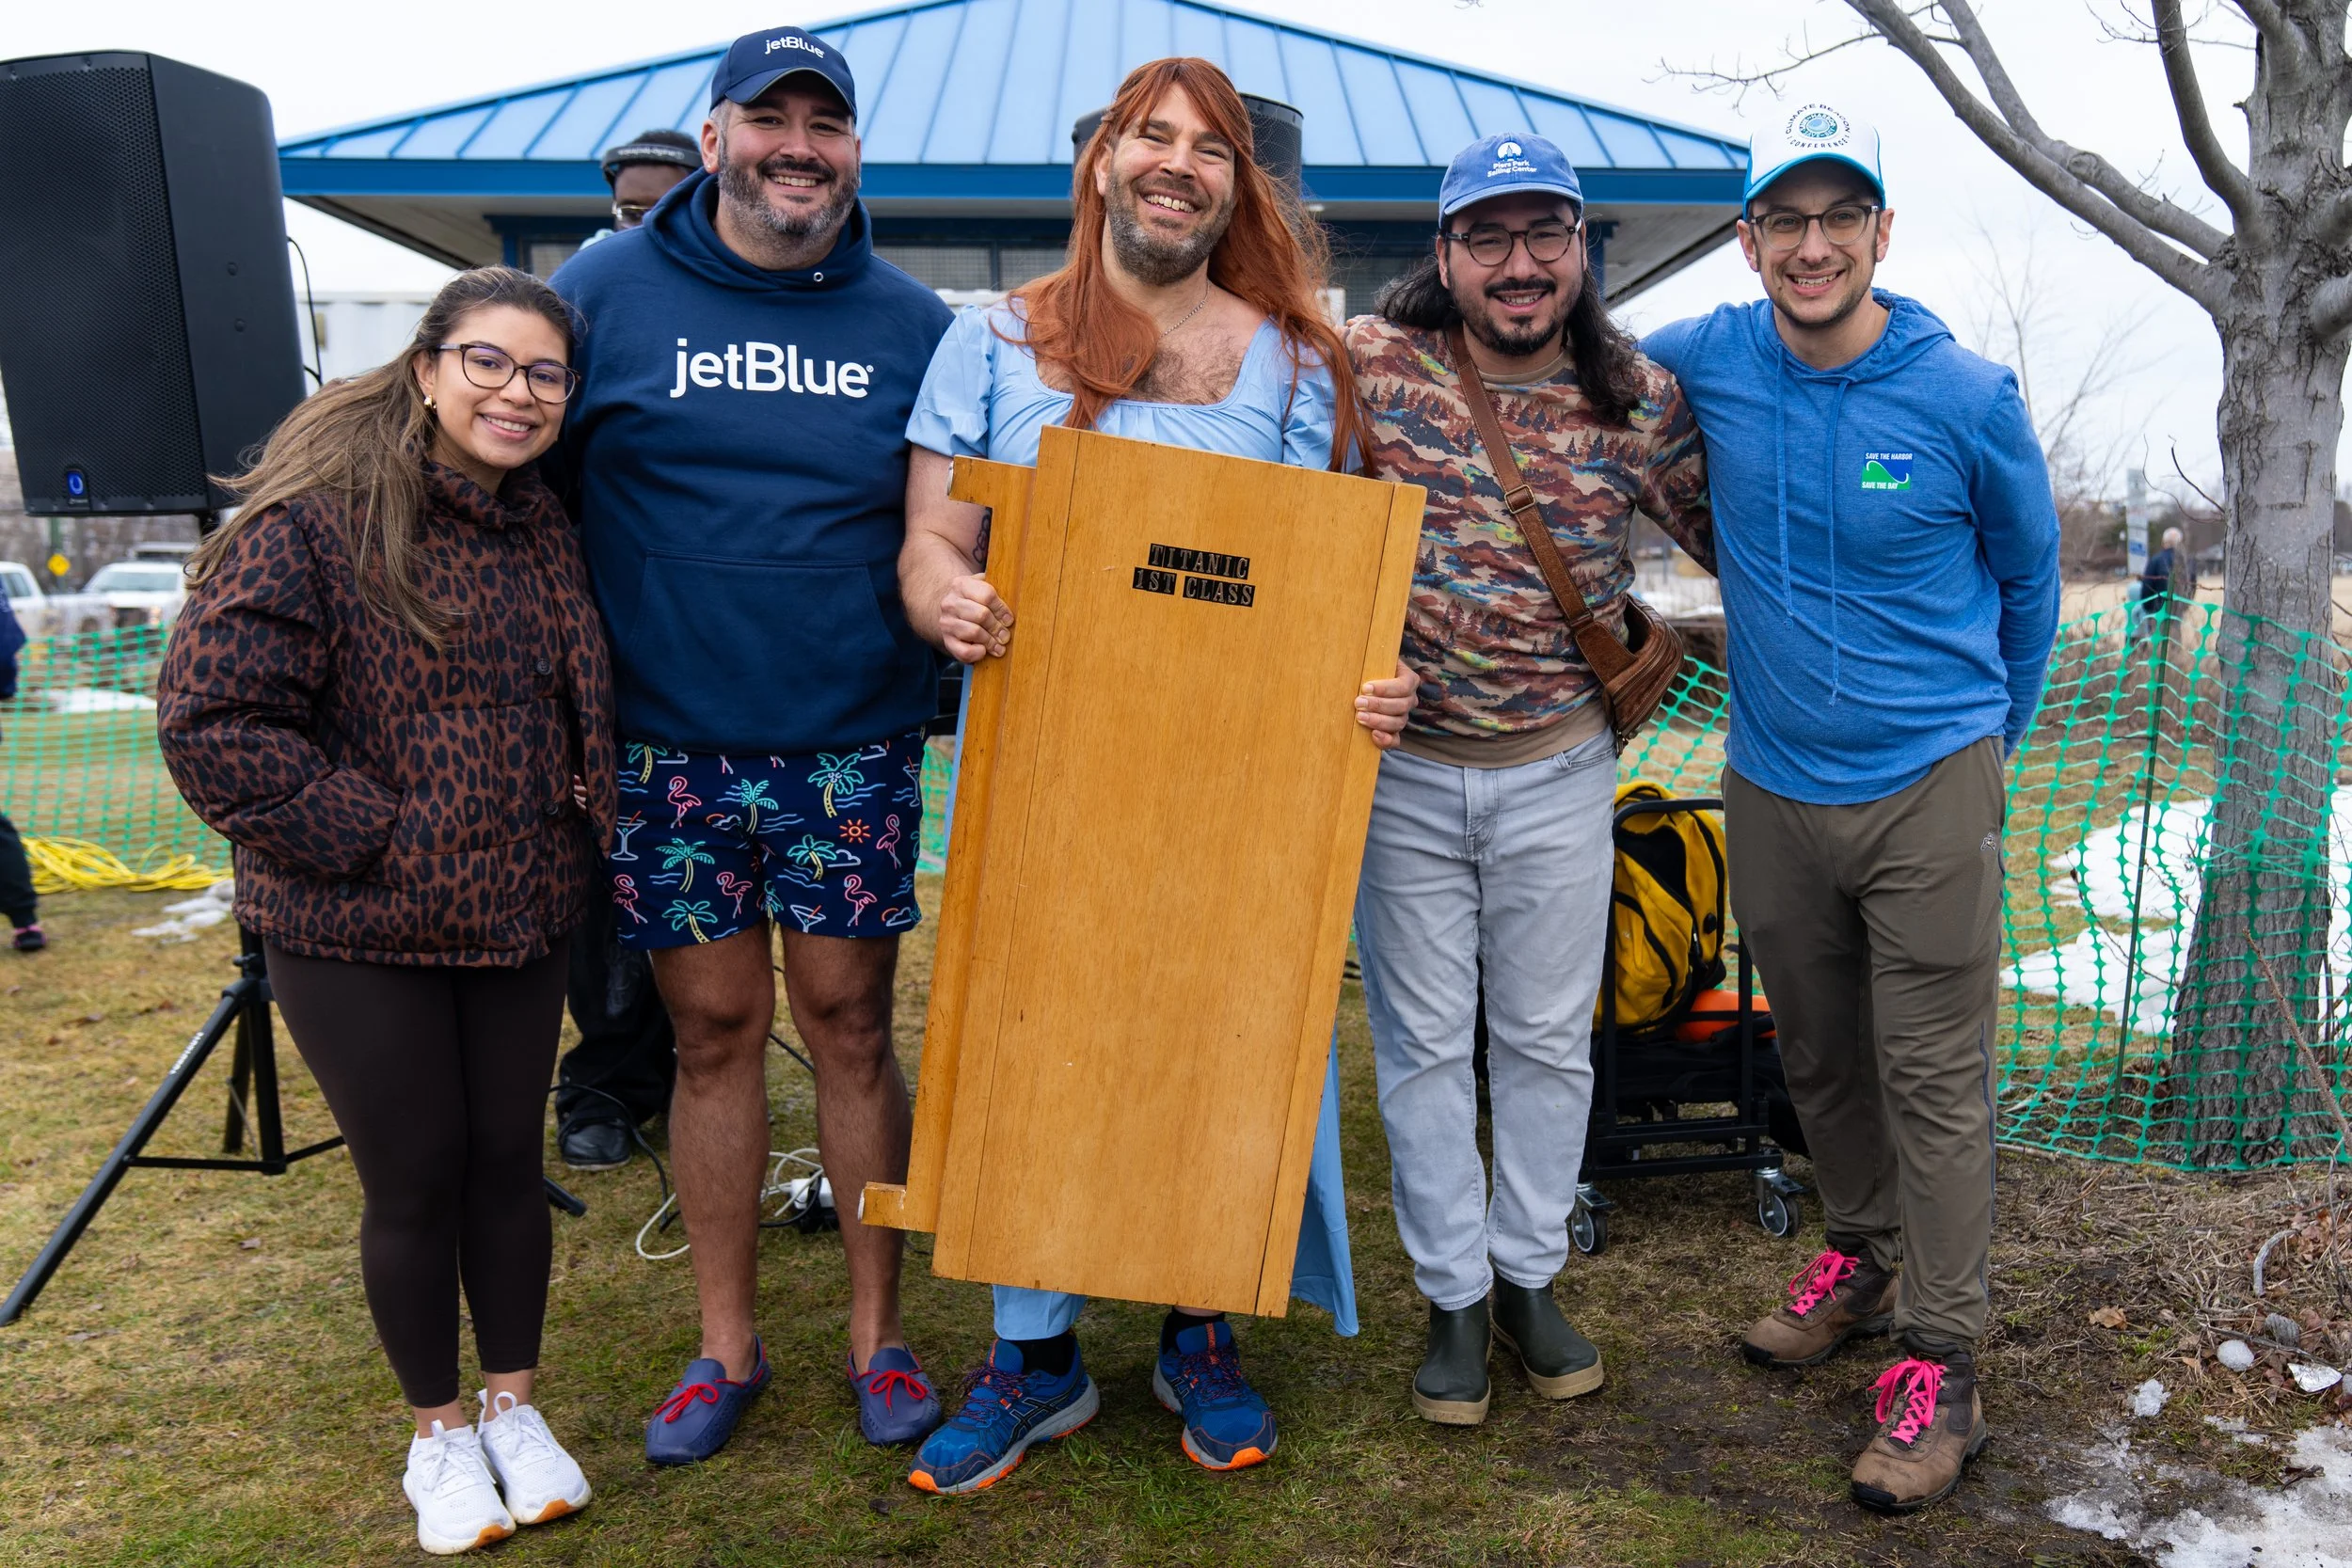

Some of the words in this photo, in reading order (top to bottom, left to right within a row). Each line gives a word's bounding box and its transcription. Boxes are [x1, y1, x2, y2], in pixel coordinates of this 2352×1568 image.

[764, 36, 824, 58] jetBlue
[1786, 103, 1816, 135] CLIMATE
[1820, 103, 1851, 134] BEACON
[1789, 138, 1849, 149] CONFERENCE
[1486, 167, 1512, 178] Sailing
[1512, 166, 1537, 174] Center
[669, 338, 870, 399] jetBlue
[1890, 452, 1913, 461] HARBOR
[1887, 482, 1899, 490] BAY
[1151, 544, 1248, 579] TITANIC
[1135, 569, 1176, 594] 1ST
[1185, 577, 1254, 606] CLASS
